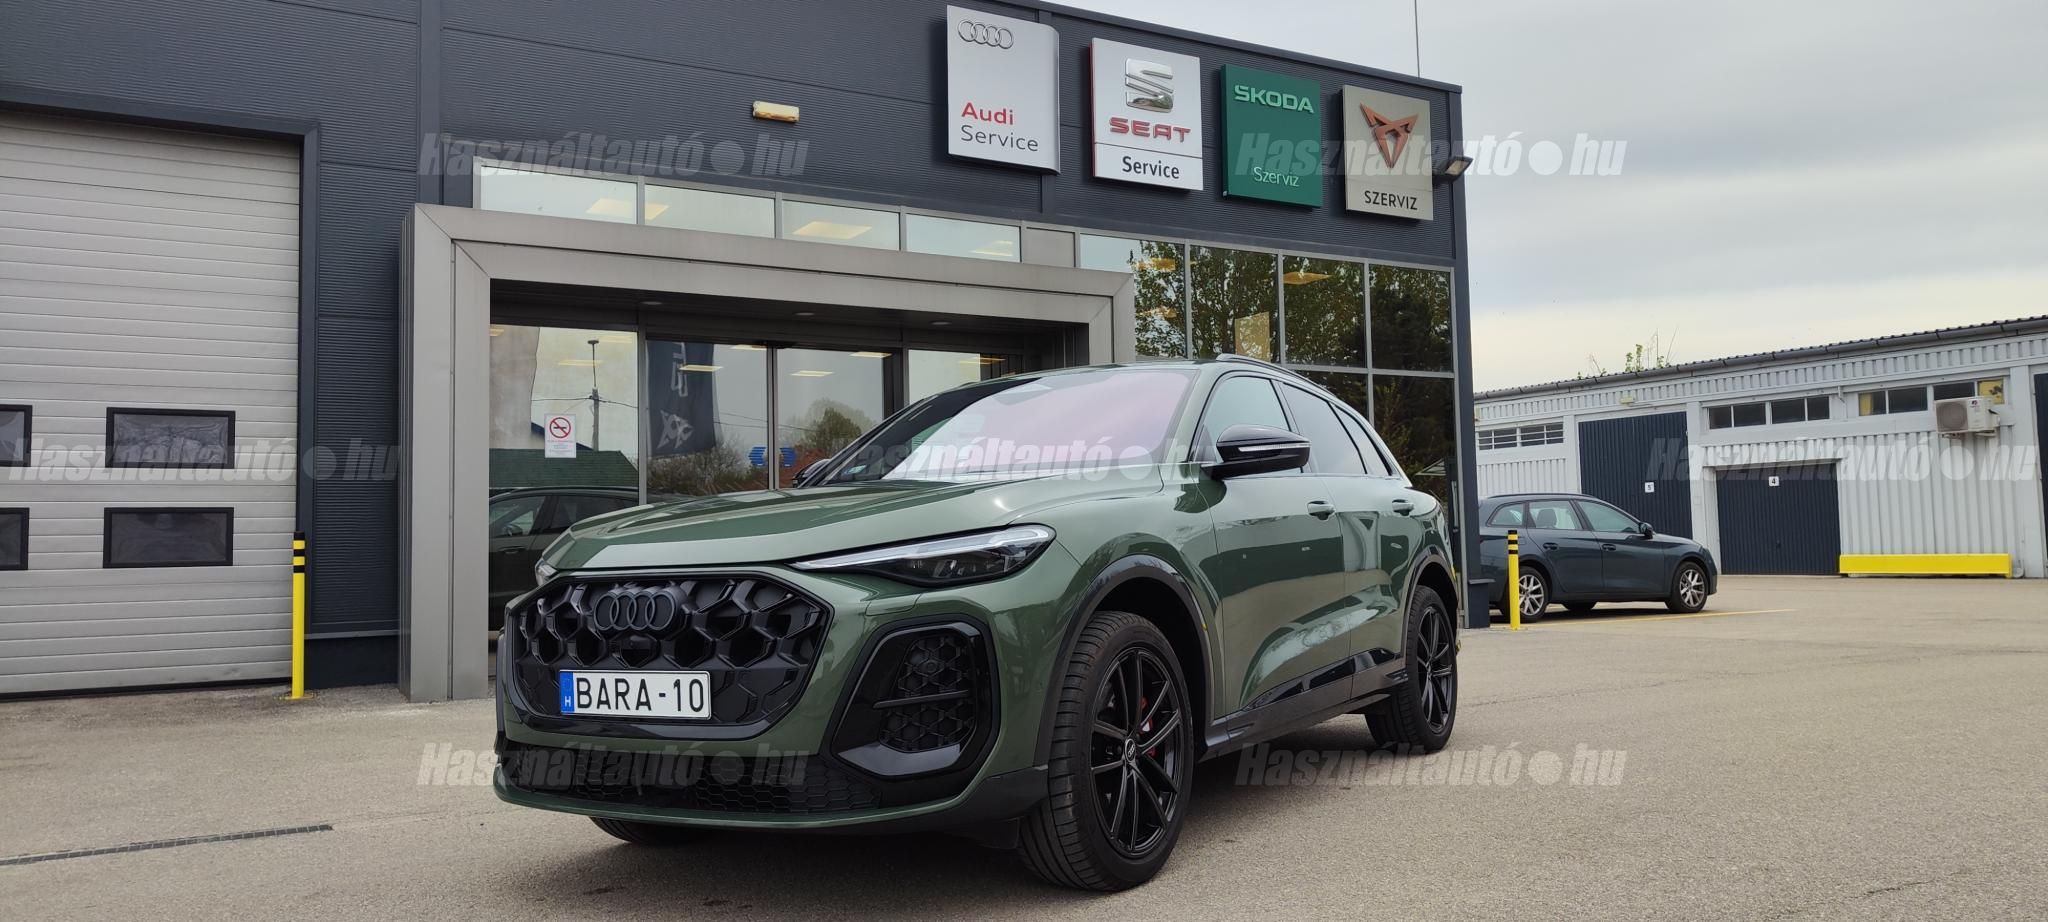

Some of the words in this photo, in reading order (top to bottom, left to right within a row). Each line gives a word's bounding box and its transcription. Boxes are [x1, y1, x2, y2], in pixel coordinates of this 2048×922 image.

[961, 102, 1014, 125] Audi
[960, 124, 1039, 152] Service
[1109, 116, 1191, 143] SEAT
[1122, 155, 1180, 180] Service
[1253, 166, 1300, 187] Szerviz
[1364, 190, 1418, 211] SZERVIZ
[564, 695, 572, 708] H
[576, 677, 705, 713] BARA-10
